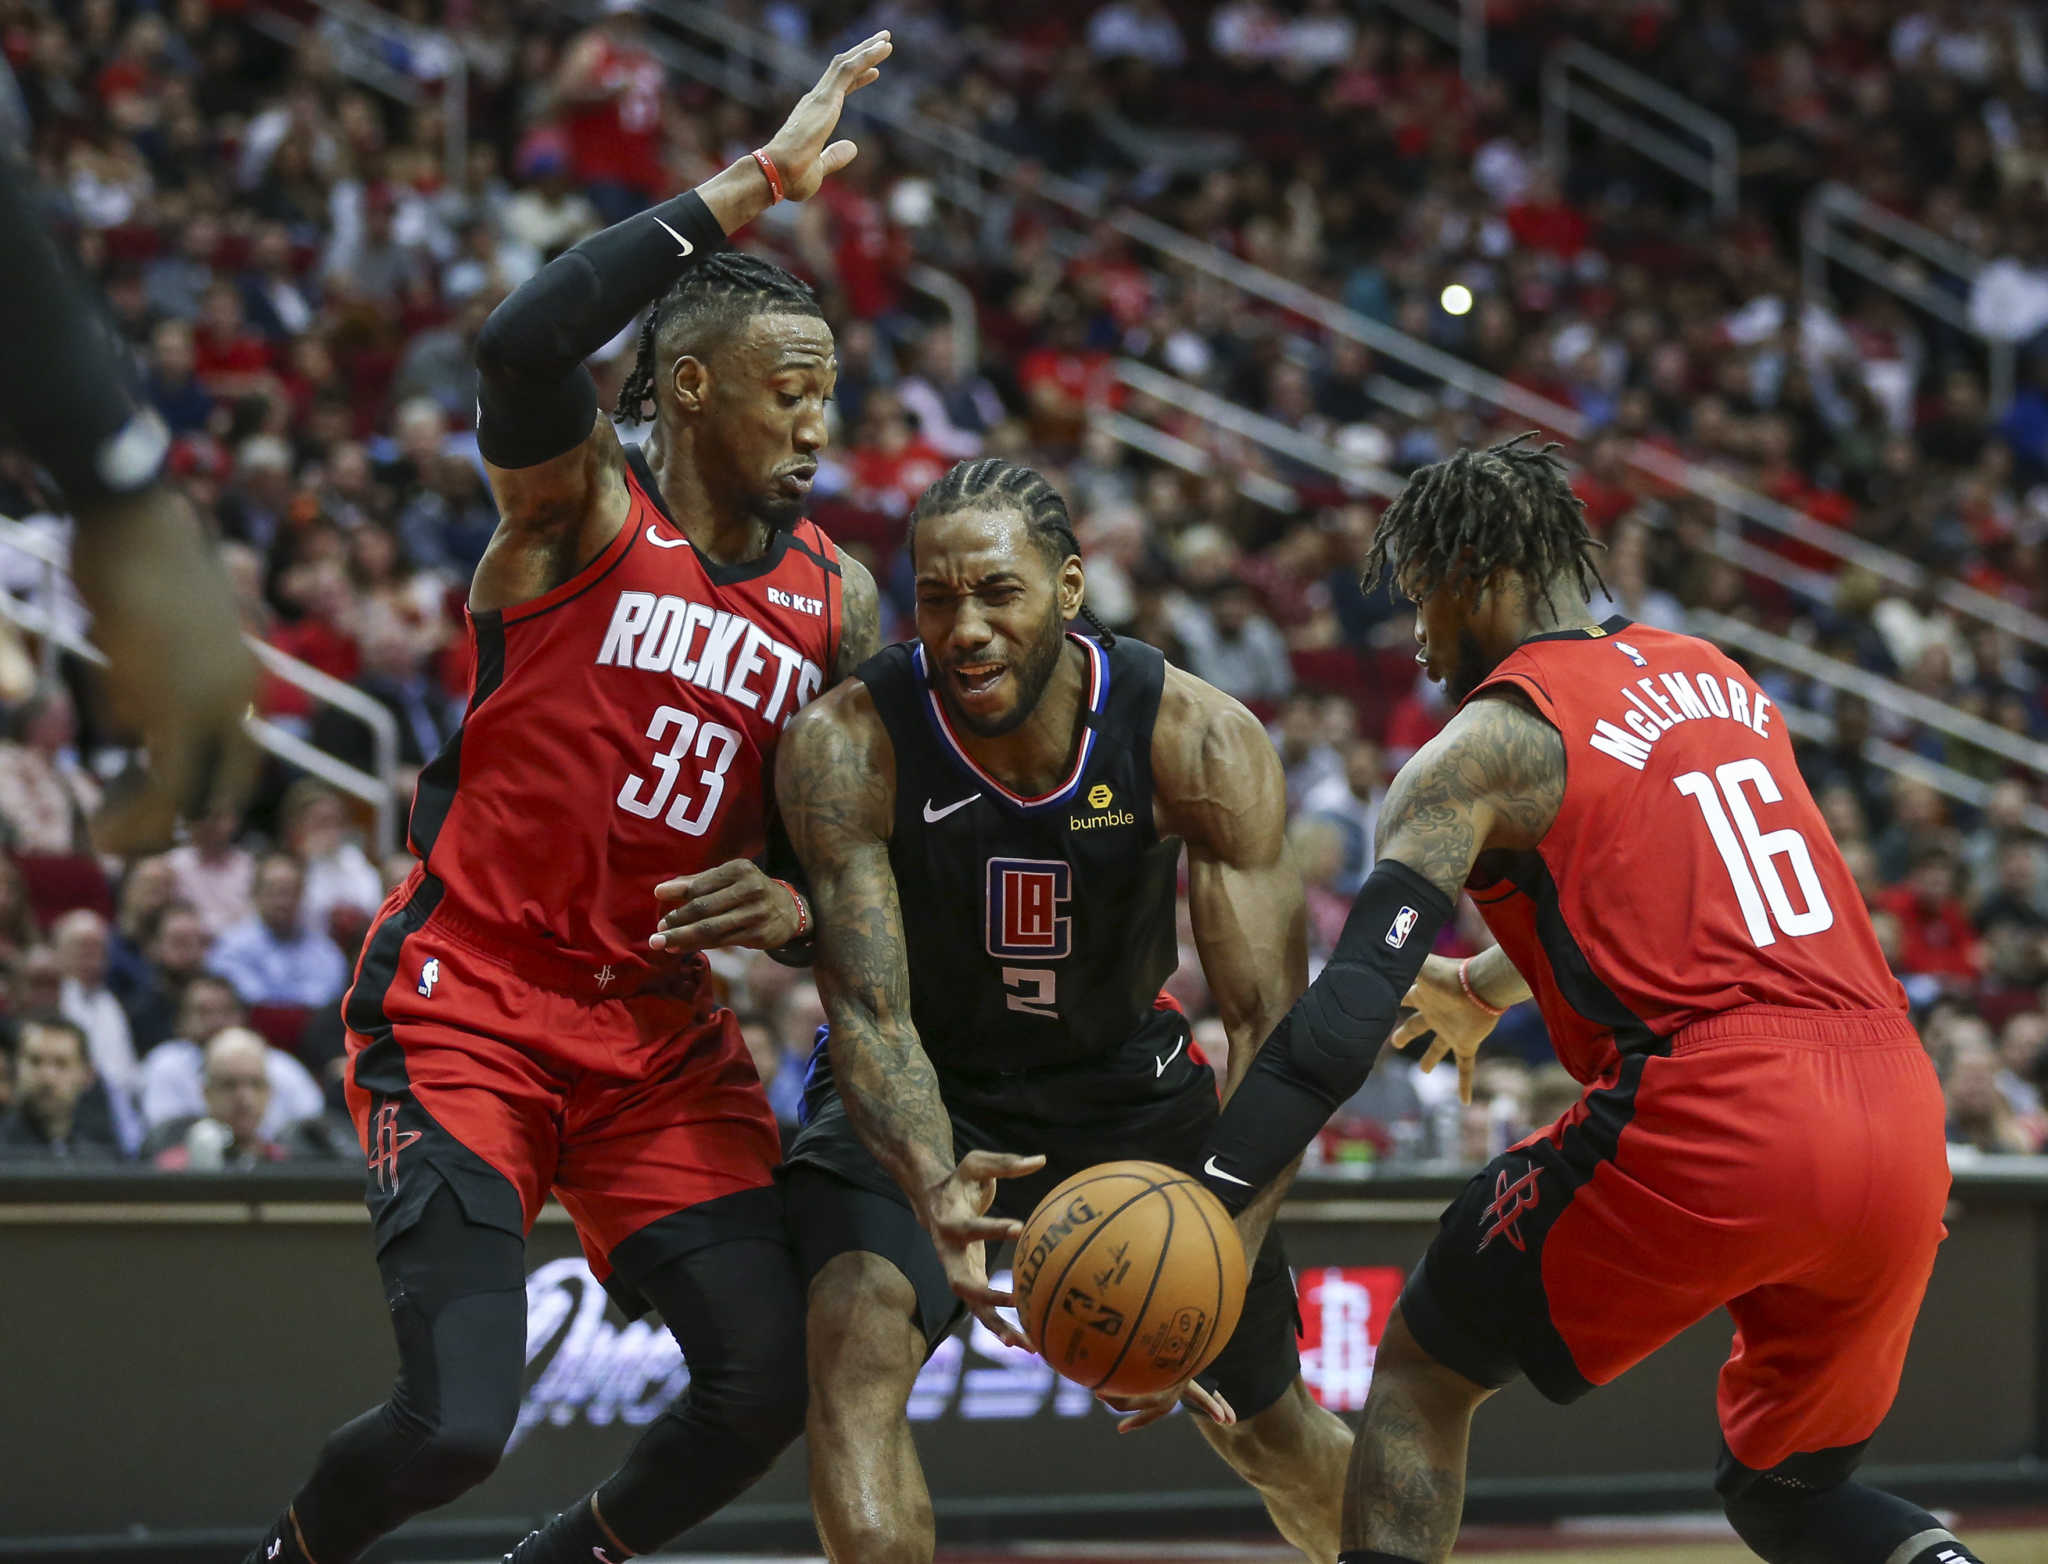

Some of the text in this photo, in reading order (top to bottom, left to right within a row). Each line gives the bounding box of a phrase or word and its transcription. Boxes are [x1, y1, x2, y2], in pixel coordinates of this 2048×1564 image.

[617, 706, 743, 837] 33
[1070, 810, 1134, 831] bumble
[1673, 758, 1834, 949] 16
[1002, 966, 1059, 1019] 2
